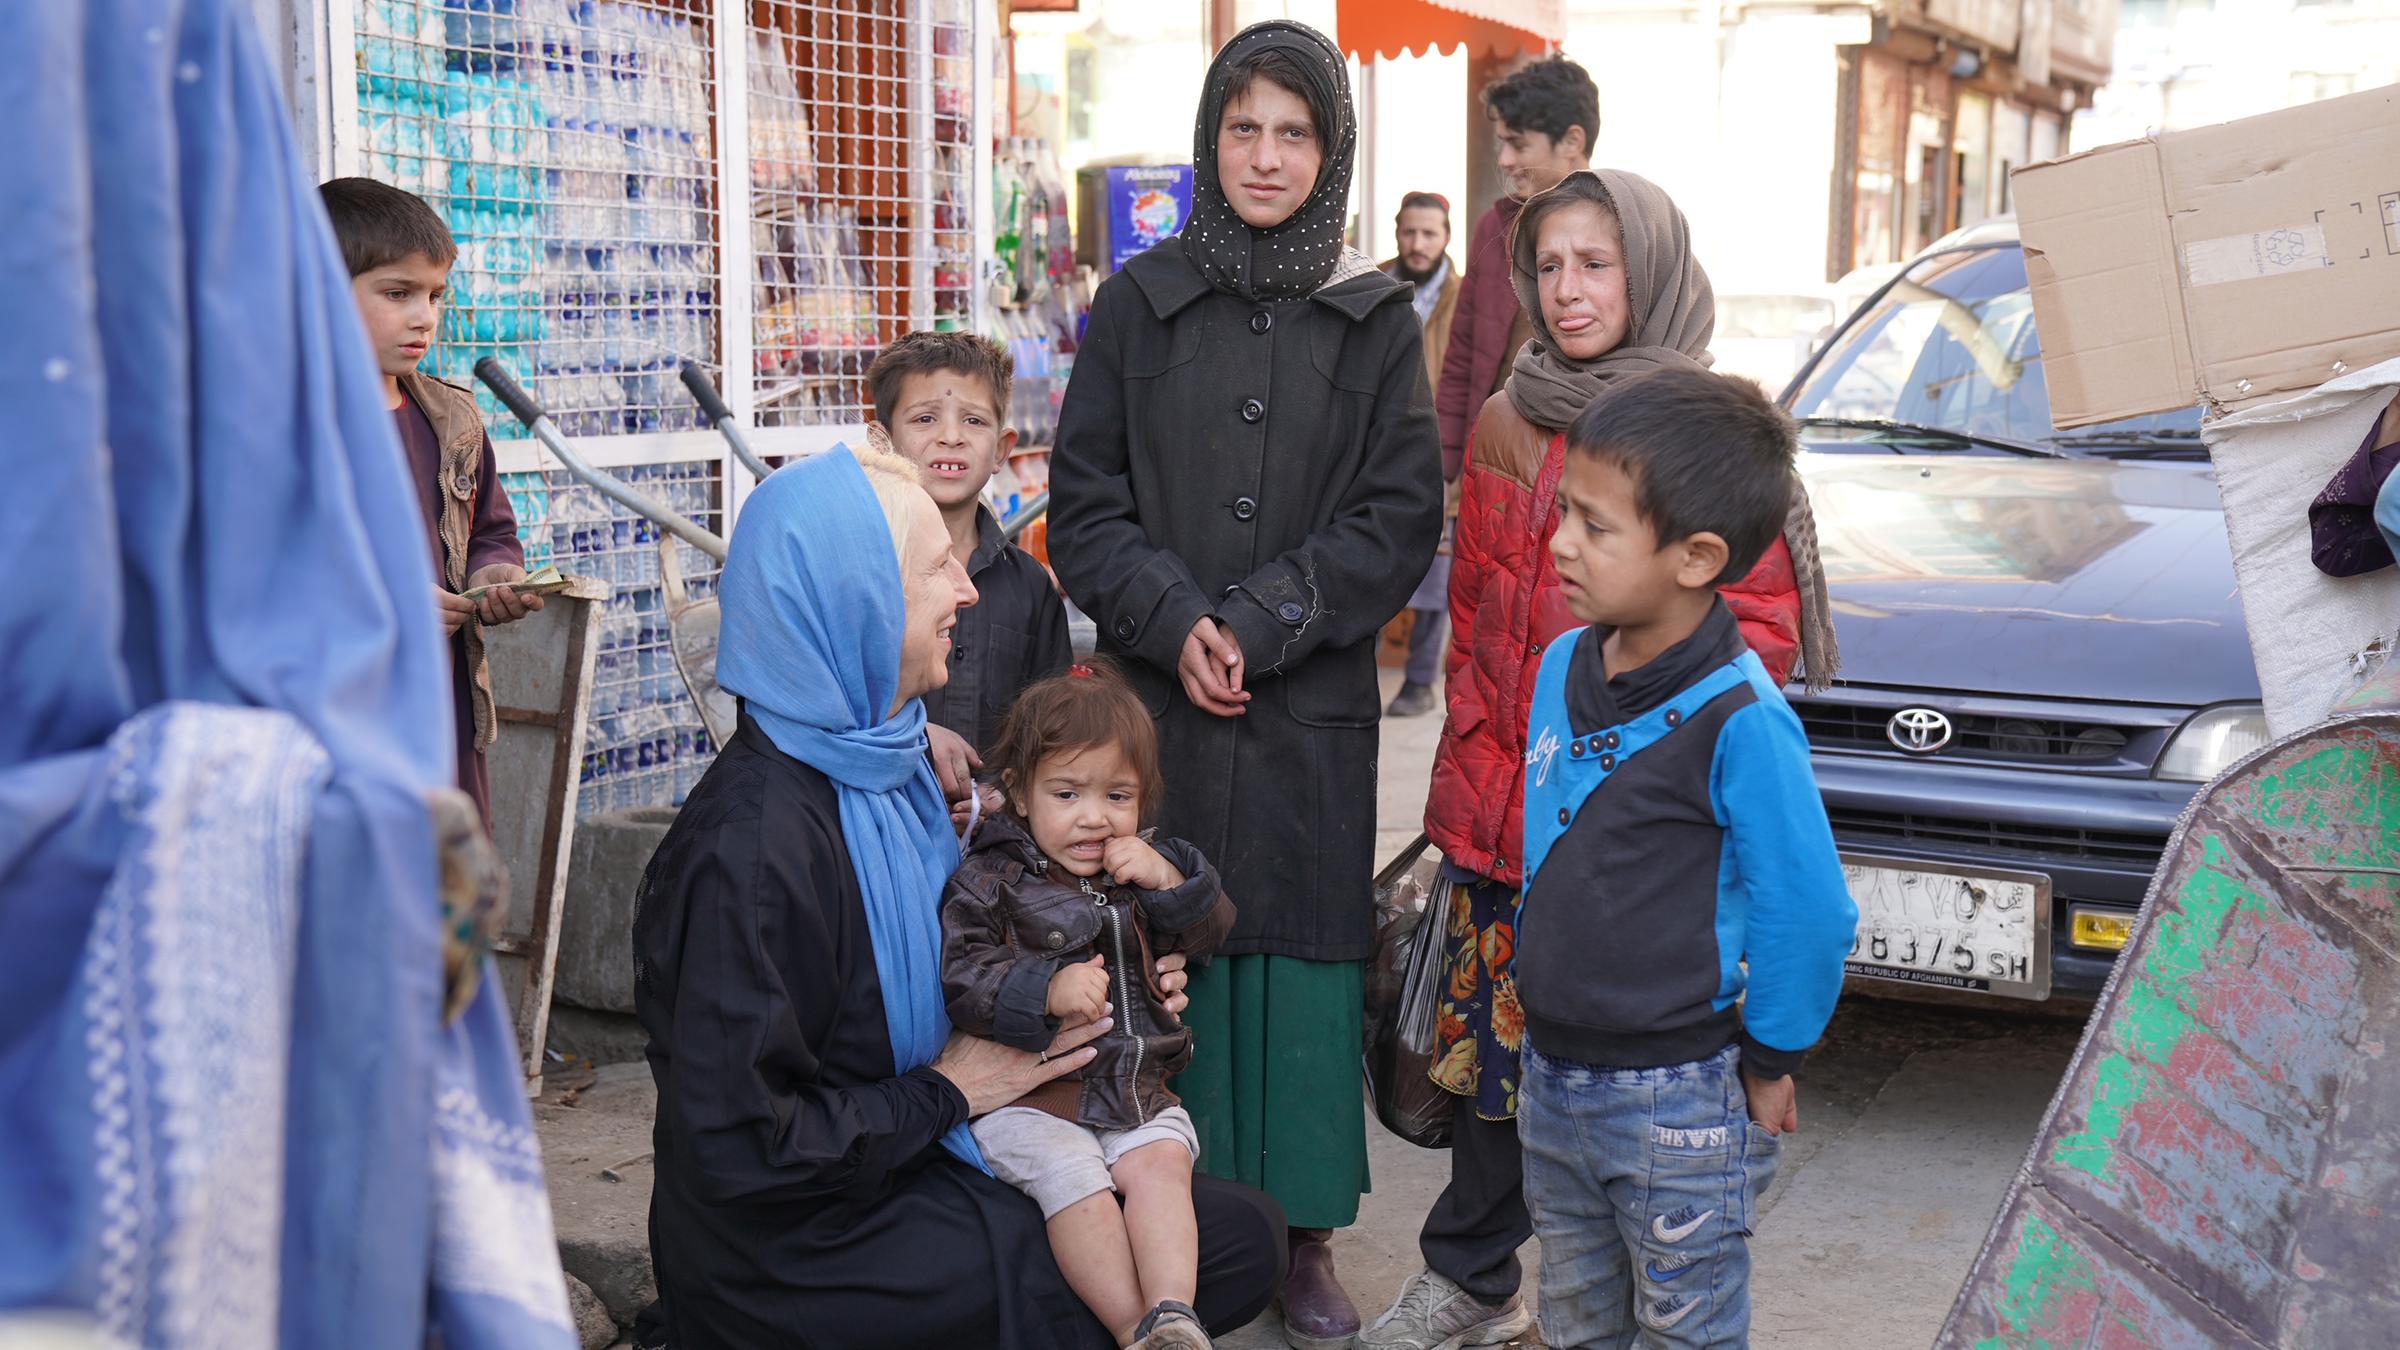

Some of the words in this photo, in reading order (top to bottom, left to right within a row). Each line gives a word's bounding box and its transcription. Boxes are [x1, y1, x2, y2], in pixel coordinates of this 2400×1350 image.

[1844, 963, 1863, 973] AMIC
[1864, 966, 1899, 978] REPUBLIC
[1900, 970, 1910, 979] OF
[1912, 971, 1964, 986] AFGHANISTAN
[1987, 951, 2027, 981] SH
[1666, 1204, 1698, 1229] NIKE
[1661, 1251, 1690, 1272] NIKE
[1654, 1294, 1683, 1316] NIKE
